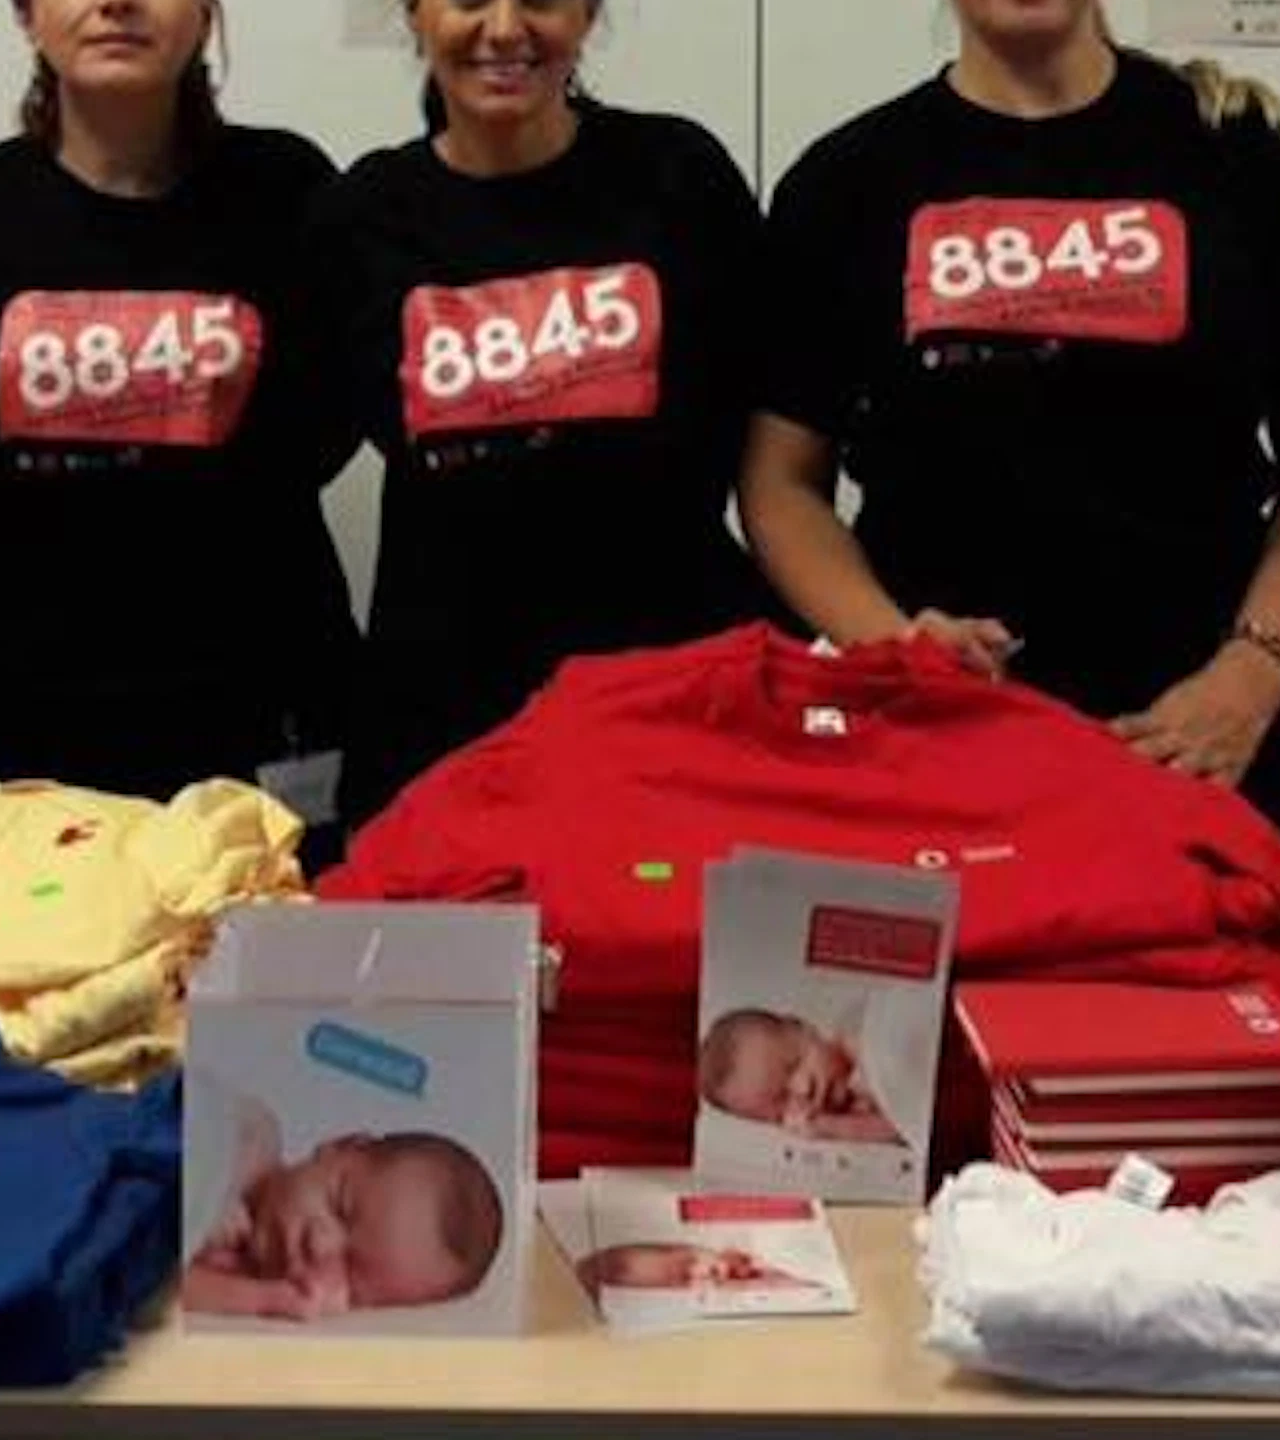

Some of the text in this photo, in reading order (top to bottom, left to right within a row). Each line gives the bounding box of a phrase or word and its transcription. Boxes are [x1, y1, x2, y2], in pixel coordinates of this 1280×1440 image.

[929, 207, 1163, 299] 8845
[19, 297, 243, 409] 8845
[422, 273, 639, 398] 8845
